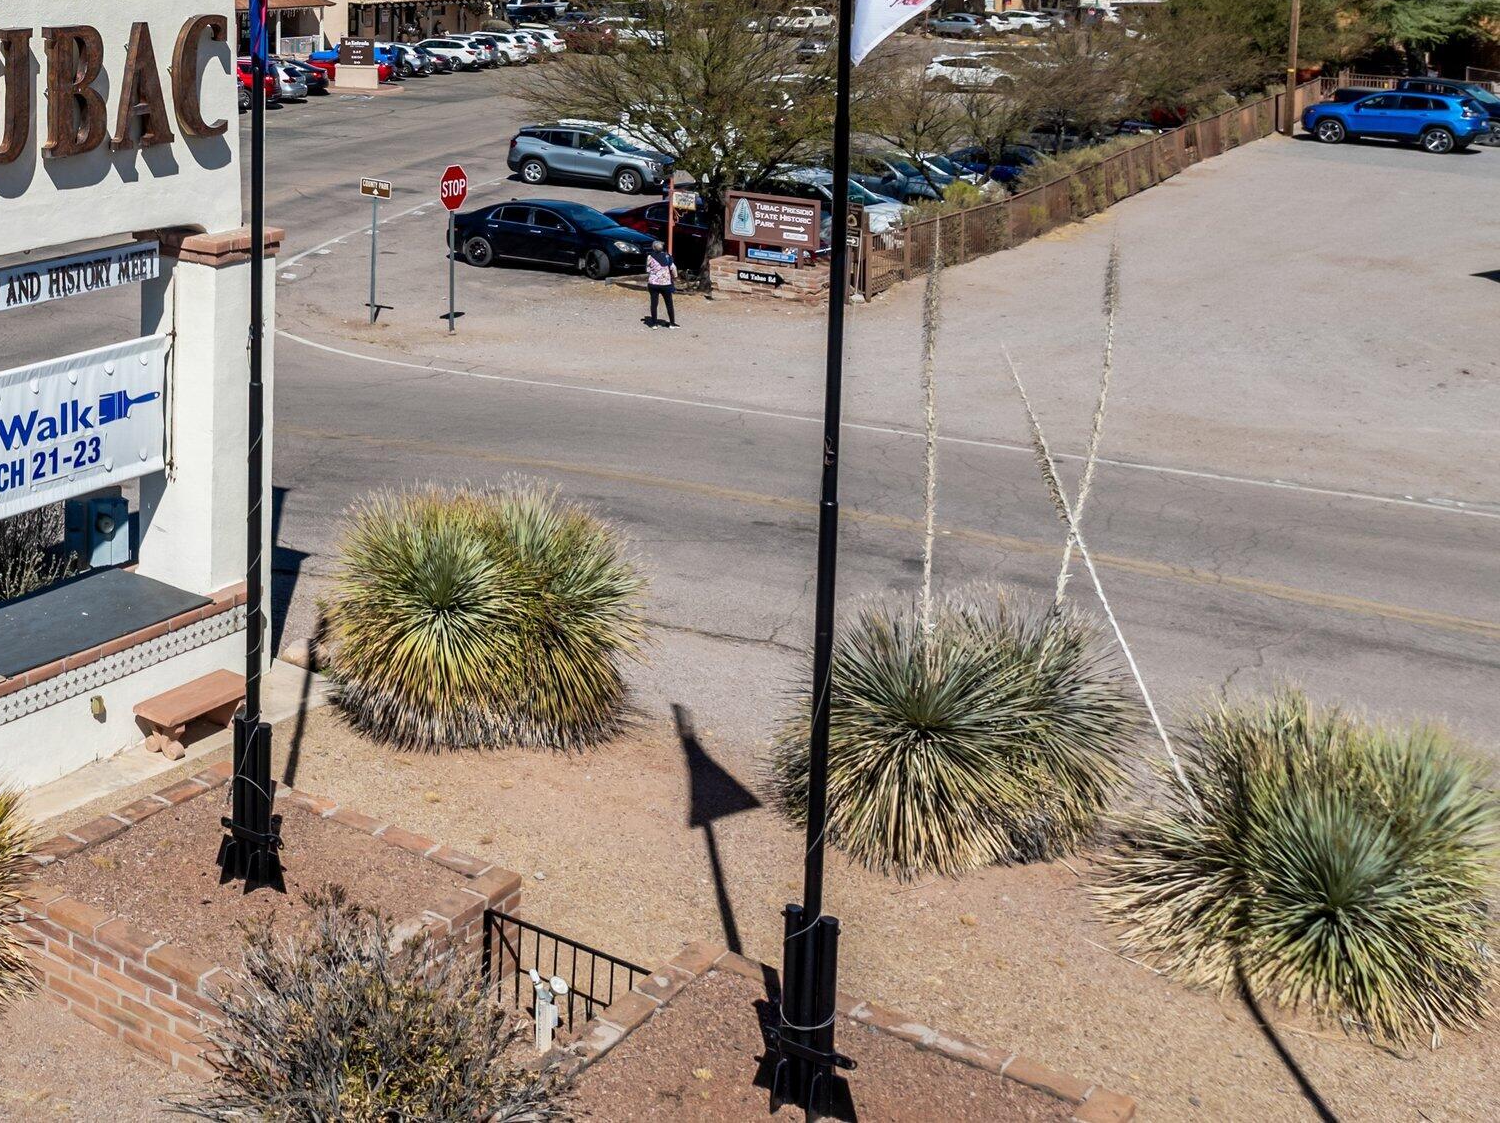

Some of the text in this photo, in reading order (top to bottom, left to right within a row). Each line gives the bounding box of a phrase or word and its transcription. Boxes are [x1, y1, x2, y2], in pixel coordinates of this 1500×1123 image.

[362, 179, 390, 190] COUNTY PARK
[442, 178, 466, 198] STOP
[755, 202, 814, 217] TUBAC PRESIDIO
[754, 211, 812, 225] STATE HISTORIC
[754, 219, 775, 229] PARK
[6, 270, 41, 307] AND
[48, 256, 113, 299] HISTORY
[117, 248, 157, 287] MEET
[32, 436, 101, 481] 21-23
